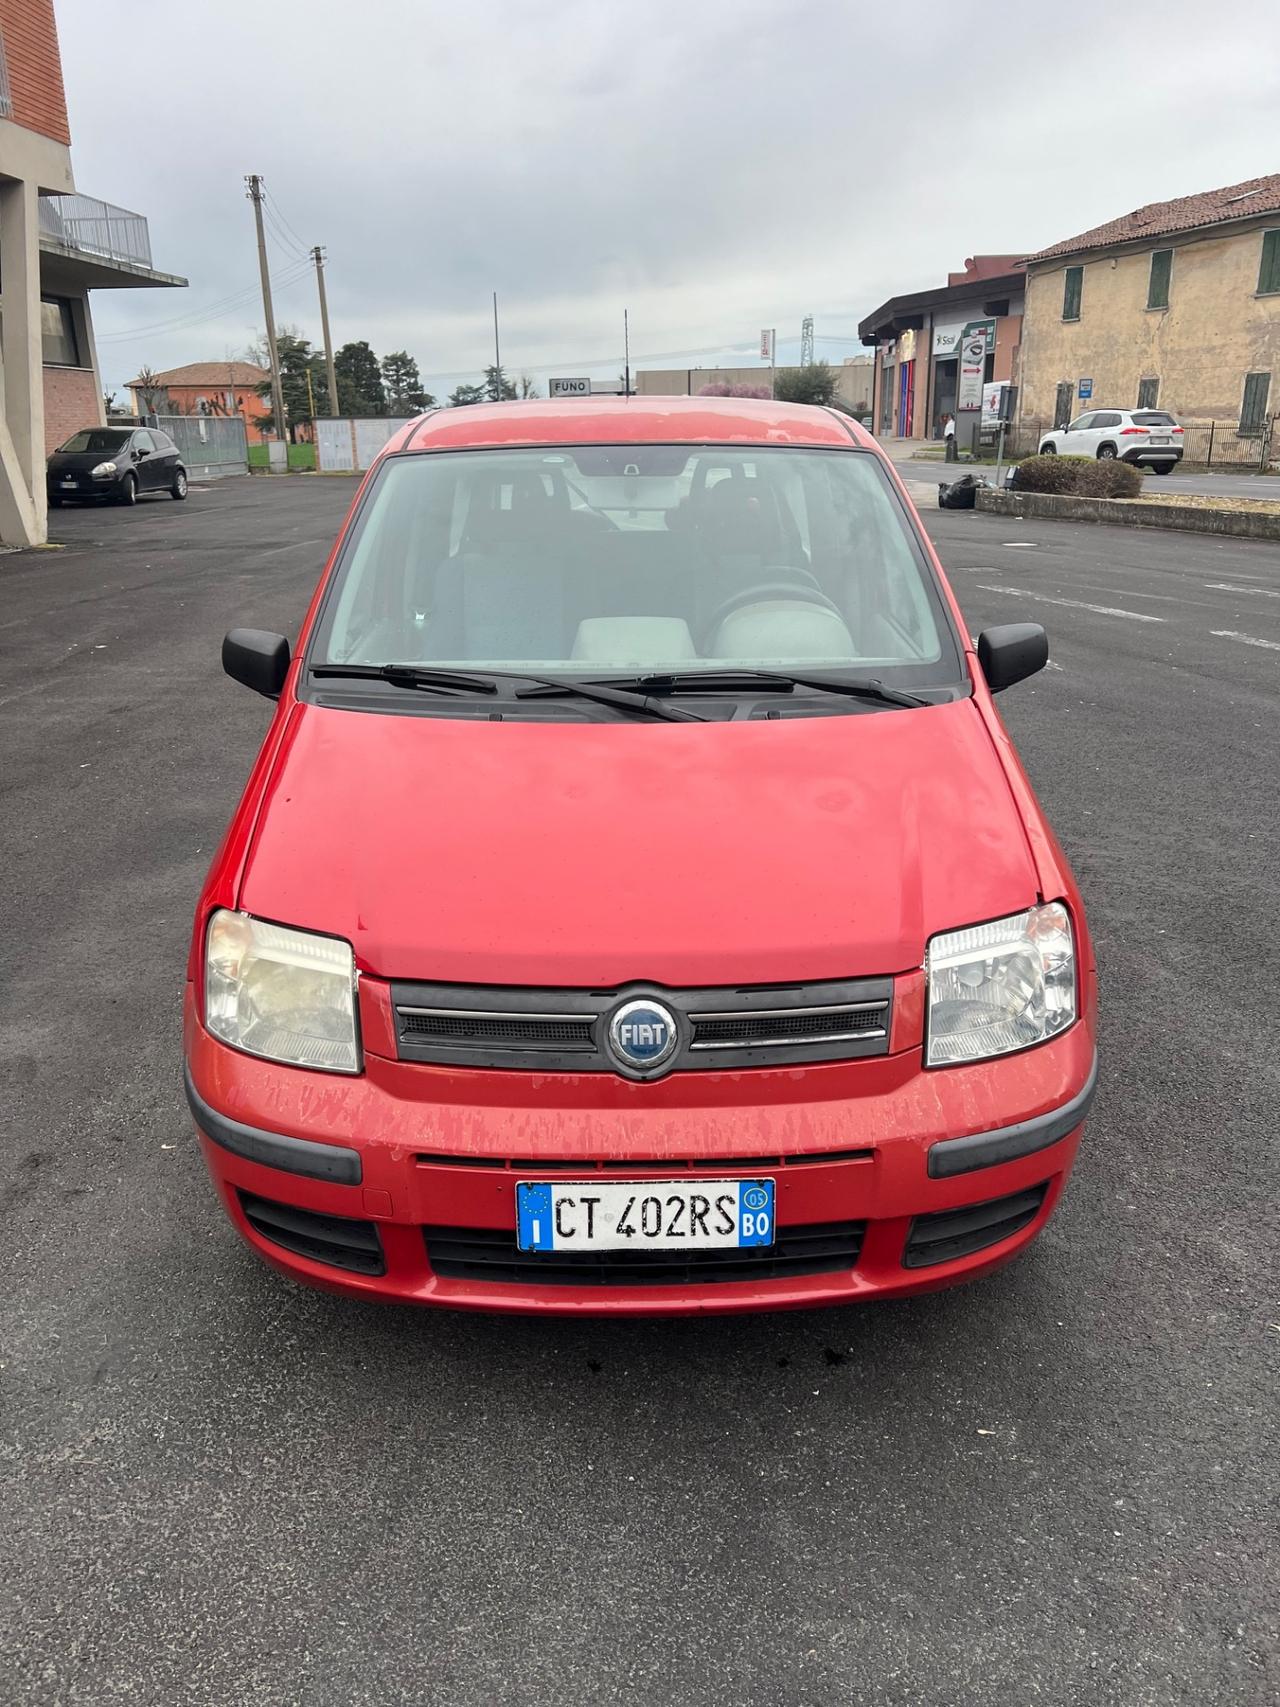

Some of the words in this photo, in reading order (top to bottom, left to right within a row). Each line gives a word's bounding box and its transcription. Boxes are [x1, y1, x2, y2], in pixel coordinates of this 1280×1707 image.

[555, 382, 586, 391] FUNO
[621, 1024, 664, 1045] FIAT
[749, 1193, 764, 1207] 05
[555, 1197, 601, 1238] CT
[616, 1195, 736, 1238] 402RS
[742, 1212, 769, 1237] BO
